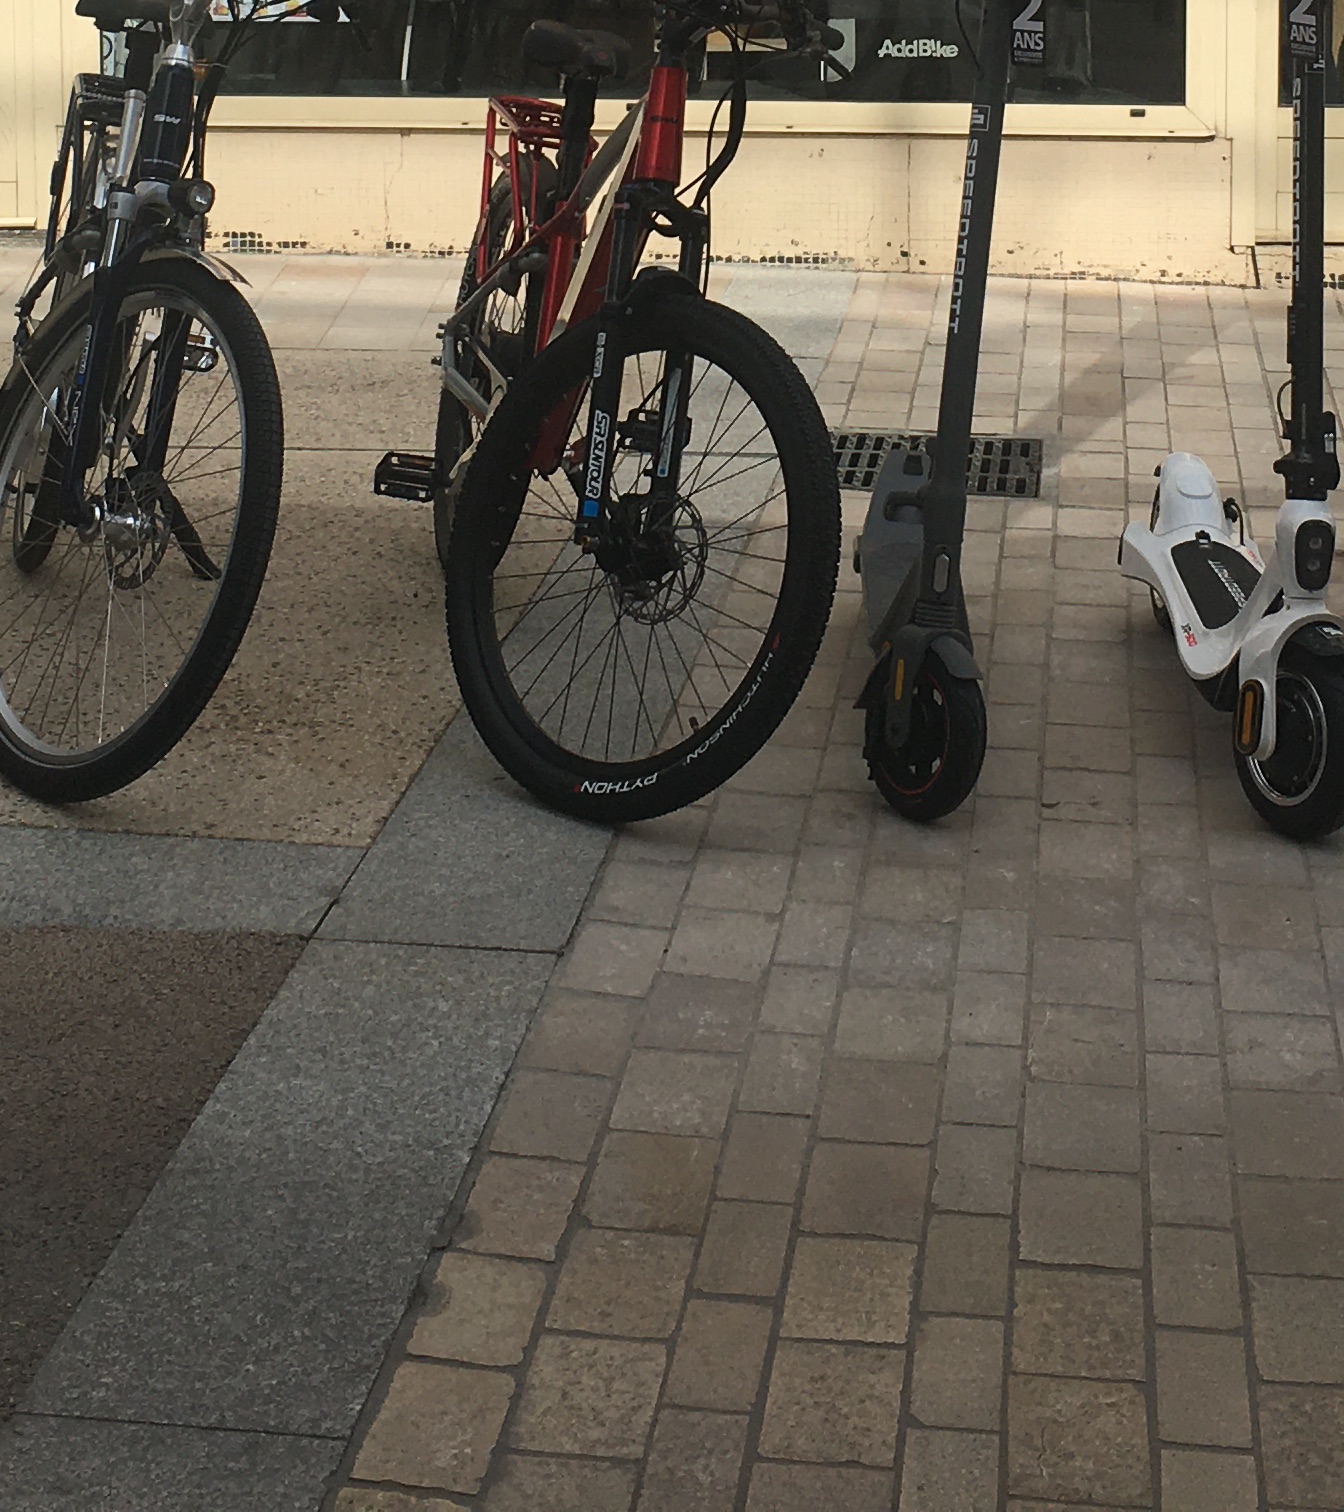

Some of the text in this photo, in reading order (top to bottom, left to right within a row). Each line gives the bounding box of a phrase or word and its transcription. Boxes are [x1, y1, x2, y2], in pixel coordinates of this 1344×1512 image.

[1013, 32, 1045, 51] ANS
[1290, 25, 1318, 45] ANS
[686, 653, 774, 764] HUTCHINSON
[580, 772, 659, 794] PYTHON
